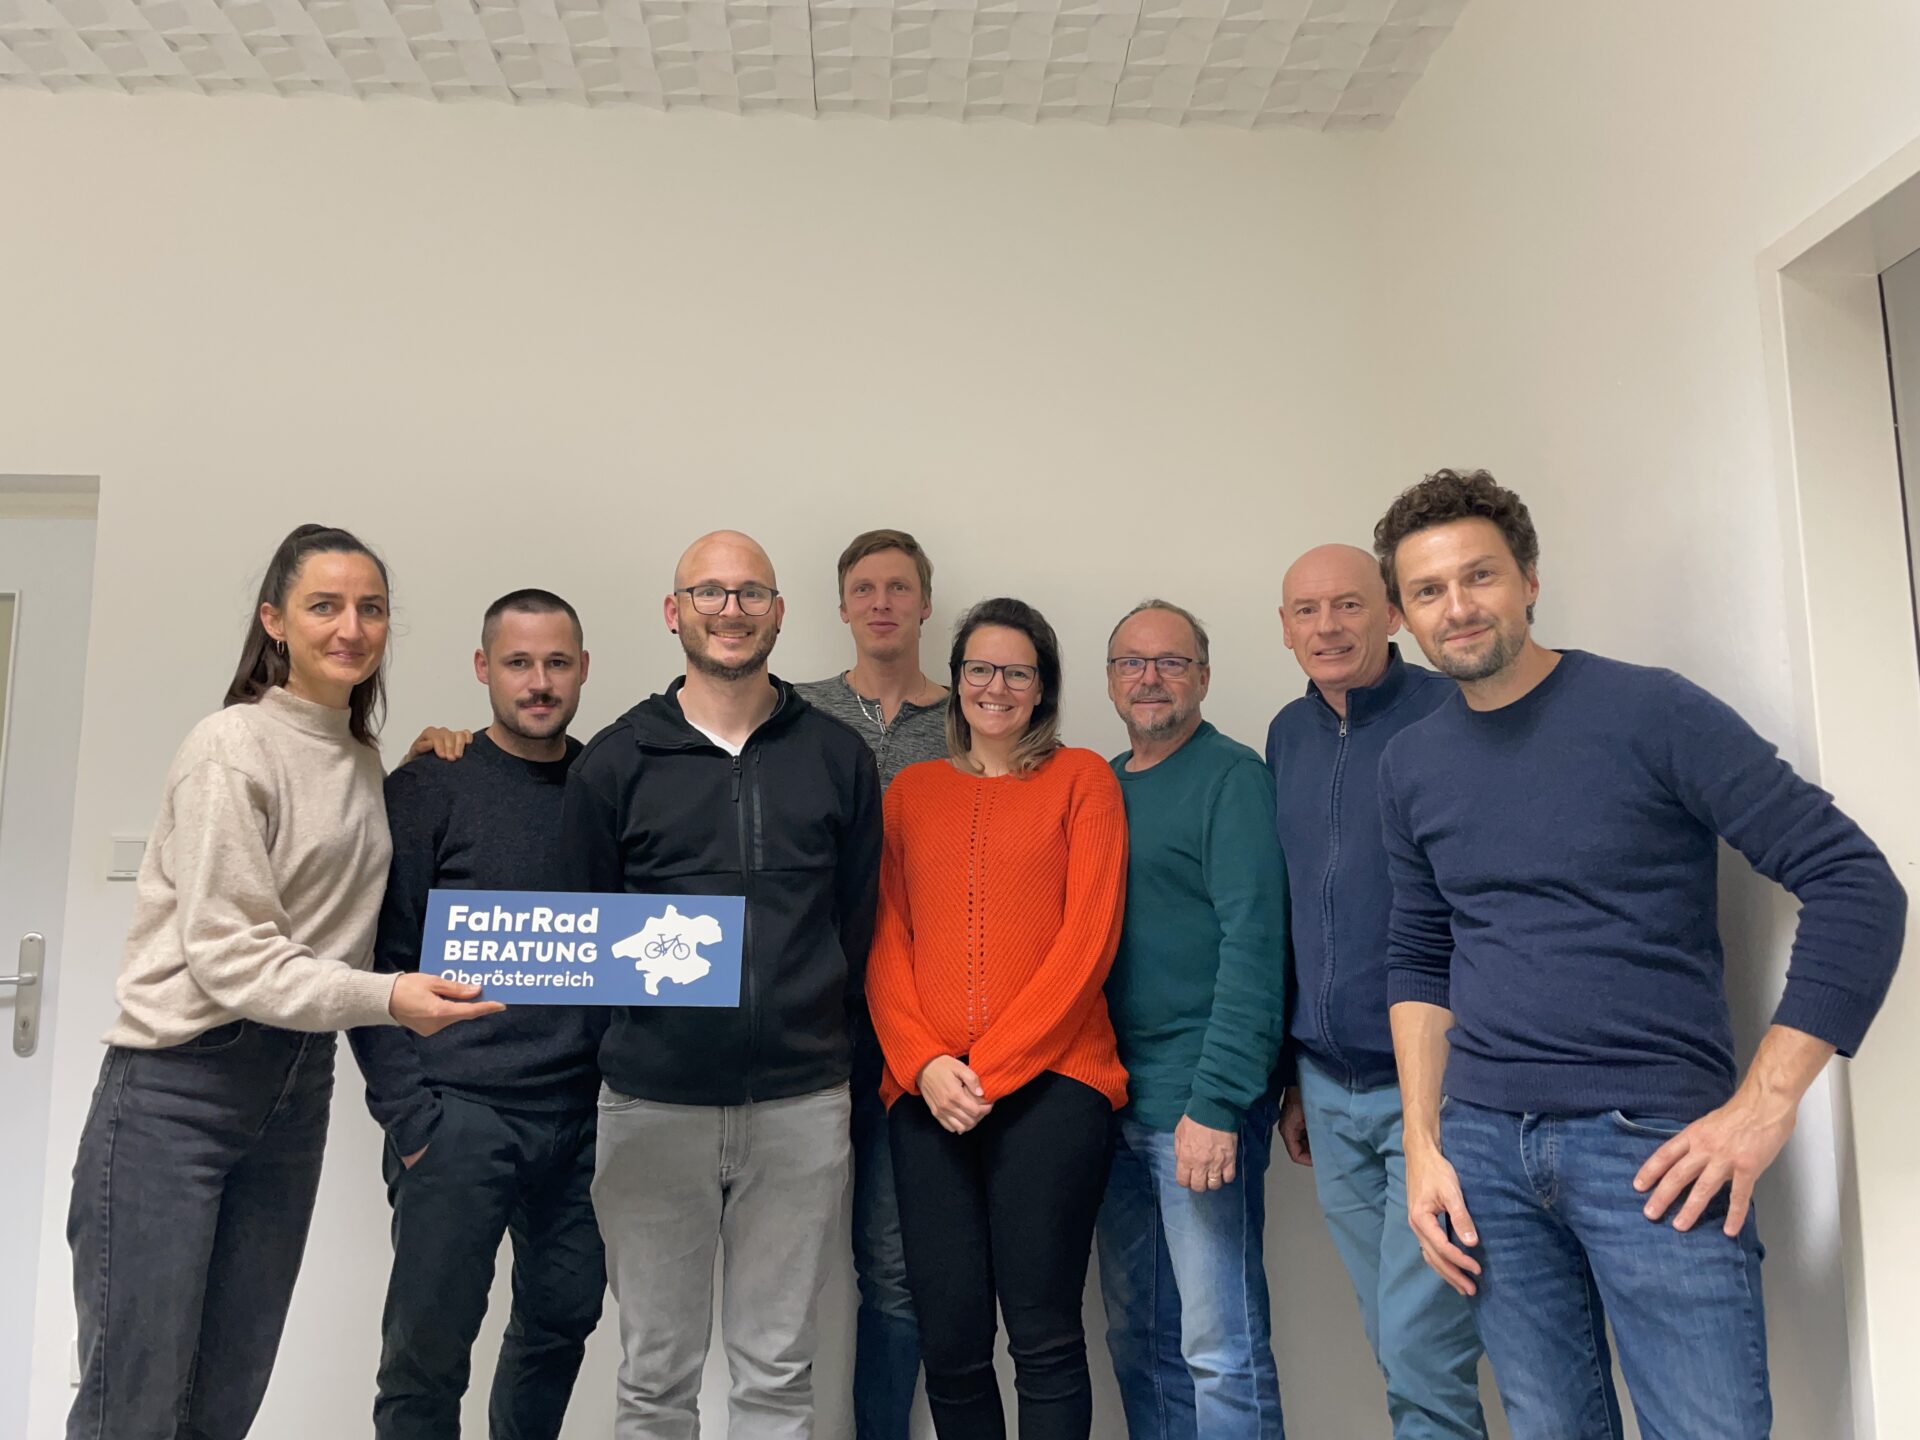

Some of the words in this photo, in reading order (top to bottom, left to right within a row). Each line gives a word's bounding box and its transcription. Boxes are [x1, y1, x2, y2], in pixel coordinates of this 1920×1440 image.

[447, 905, 599, 933] FahrRad
[443, 940, 597, 963] BERATUNG
[440, 969, 594, 987] Oberösterreich
